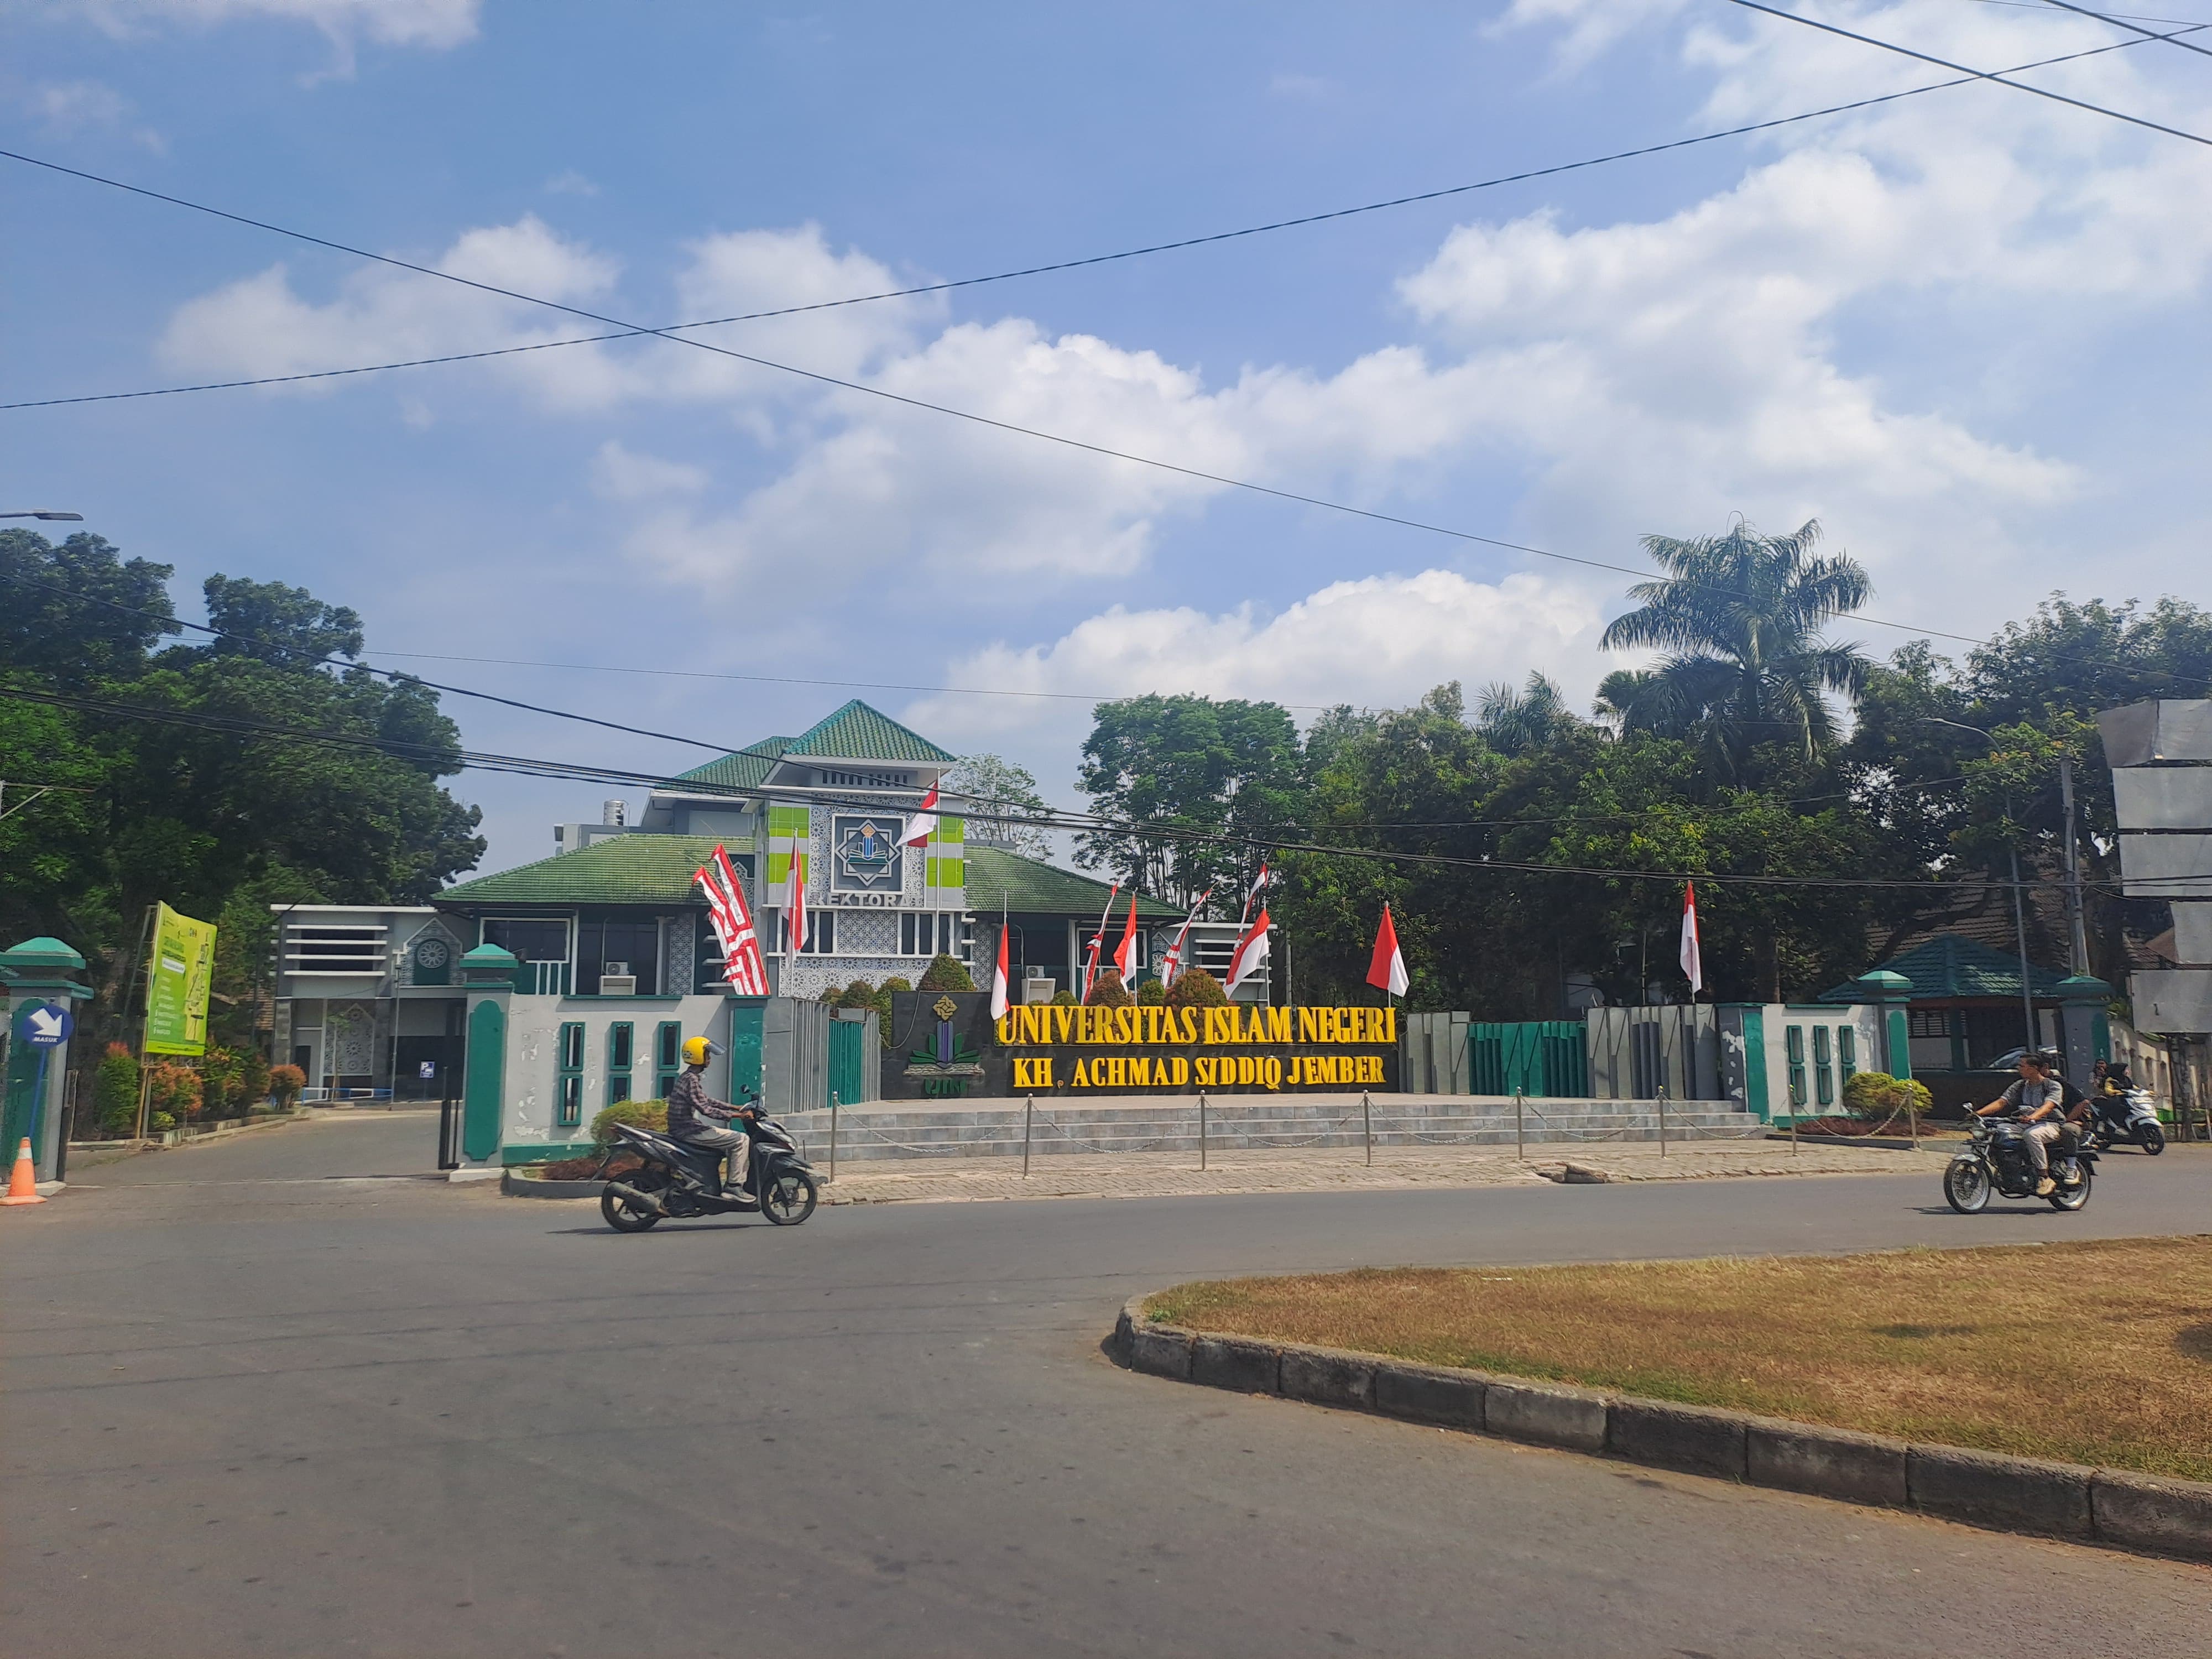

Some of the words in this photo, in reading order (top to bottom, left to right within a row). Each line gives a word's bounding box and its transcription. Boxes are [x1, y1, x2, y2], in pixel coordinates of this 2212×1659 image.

[998, 1005, 1197, 1044] UNIVERSITAS
[1203, 1006, 1293, 1044] ISLAM
[1297, 1006, 1397, 1043] NEGERI
[924, 1078, 967, 1095] UIN
[1071, 1057, 1189, 1087] ACHMAD
[1194, 1056, 1282, 1091] SIDDIQ
[1286, 1056, 1387, 1086] JEMBER
